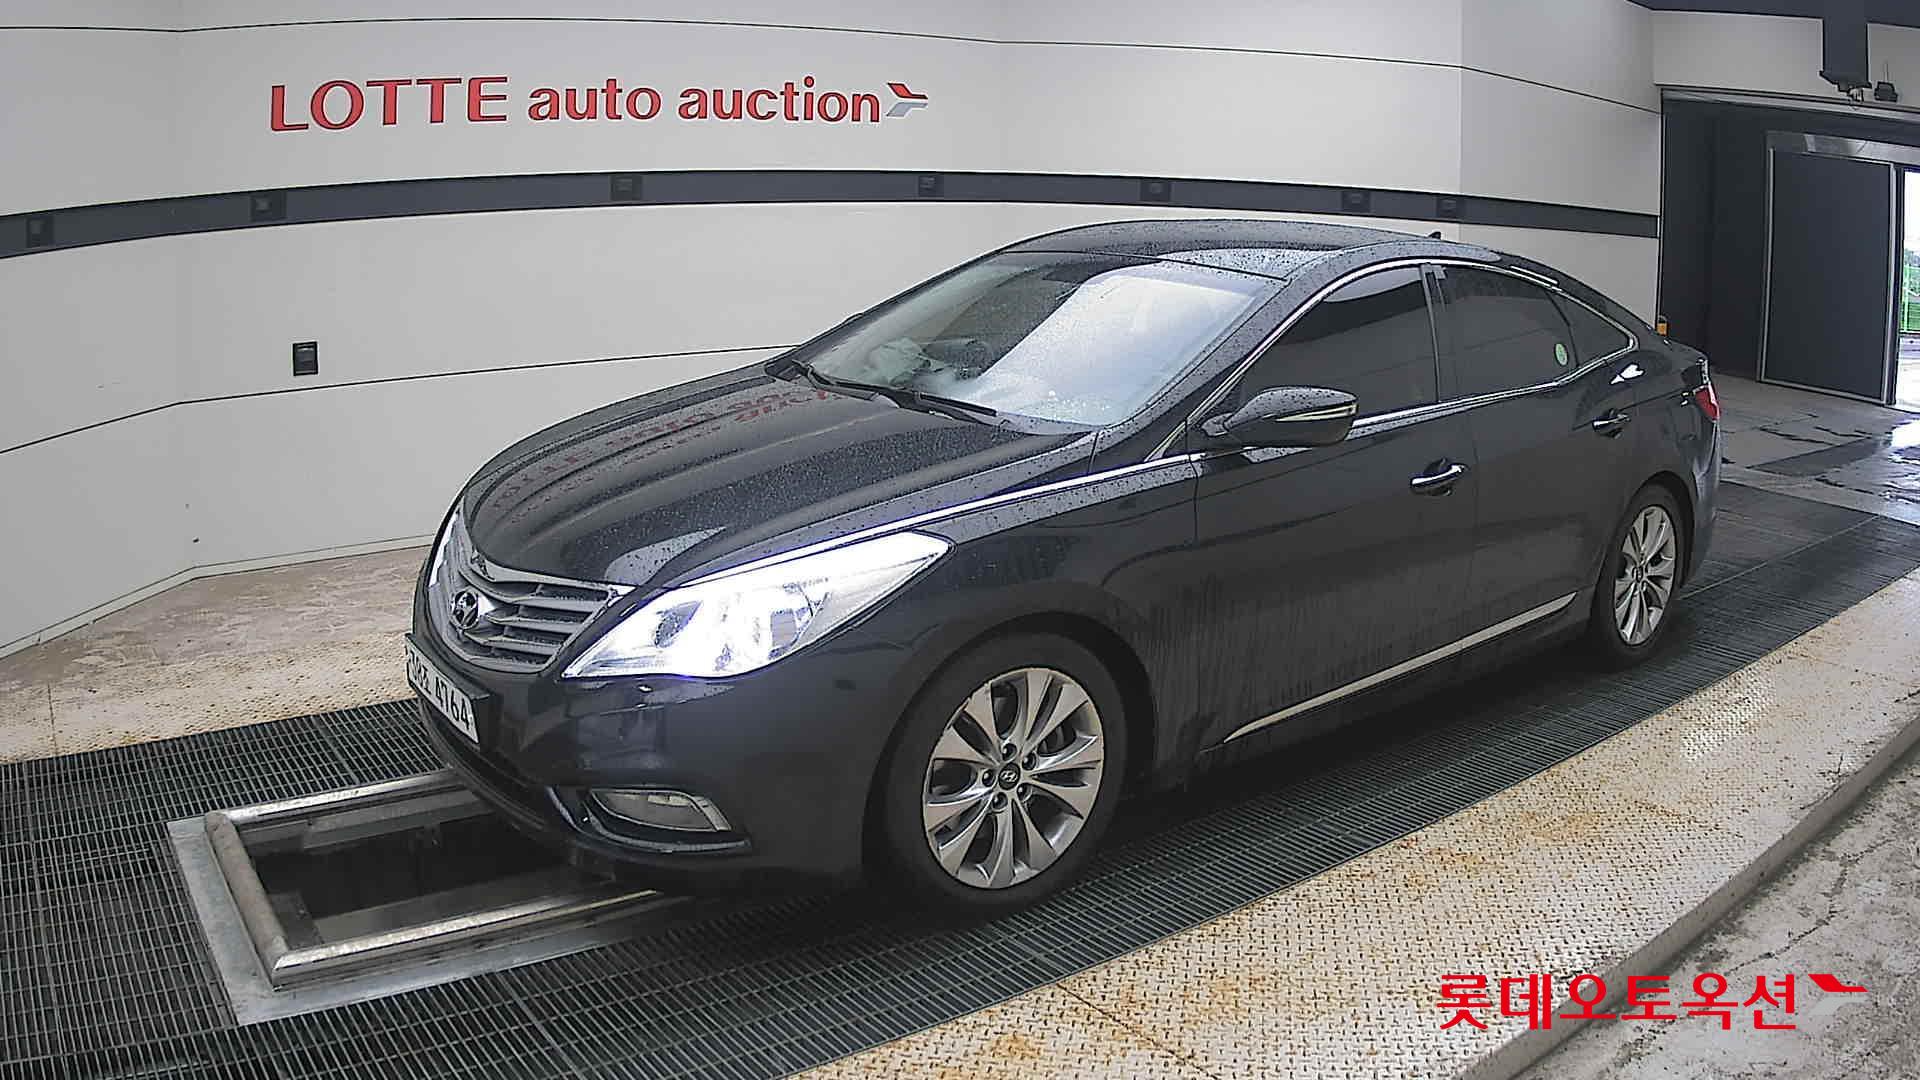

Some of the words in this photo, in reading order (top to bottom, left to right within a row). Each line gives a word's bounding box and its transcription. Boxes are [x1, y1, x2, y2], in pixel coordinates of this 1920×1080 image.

[270, 76, 508, 131] LOTTE
[527, 78, 662, 121] auto
[677, 76, 880, 122] auction
[435, 676, 470, 730] 4764
